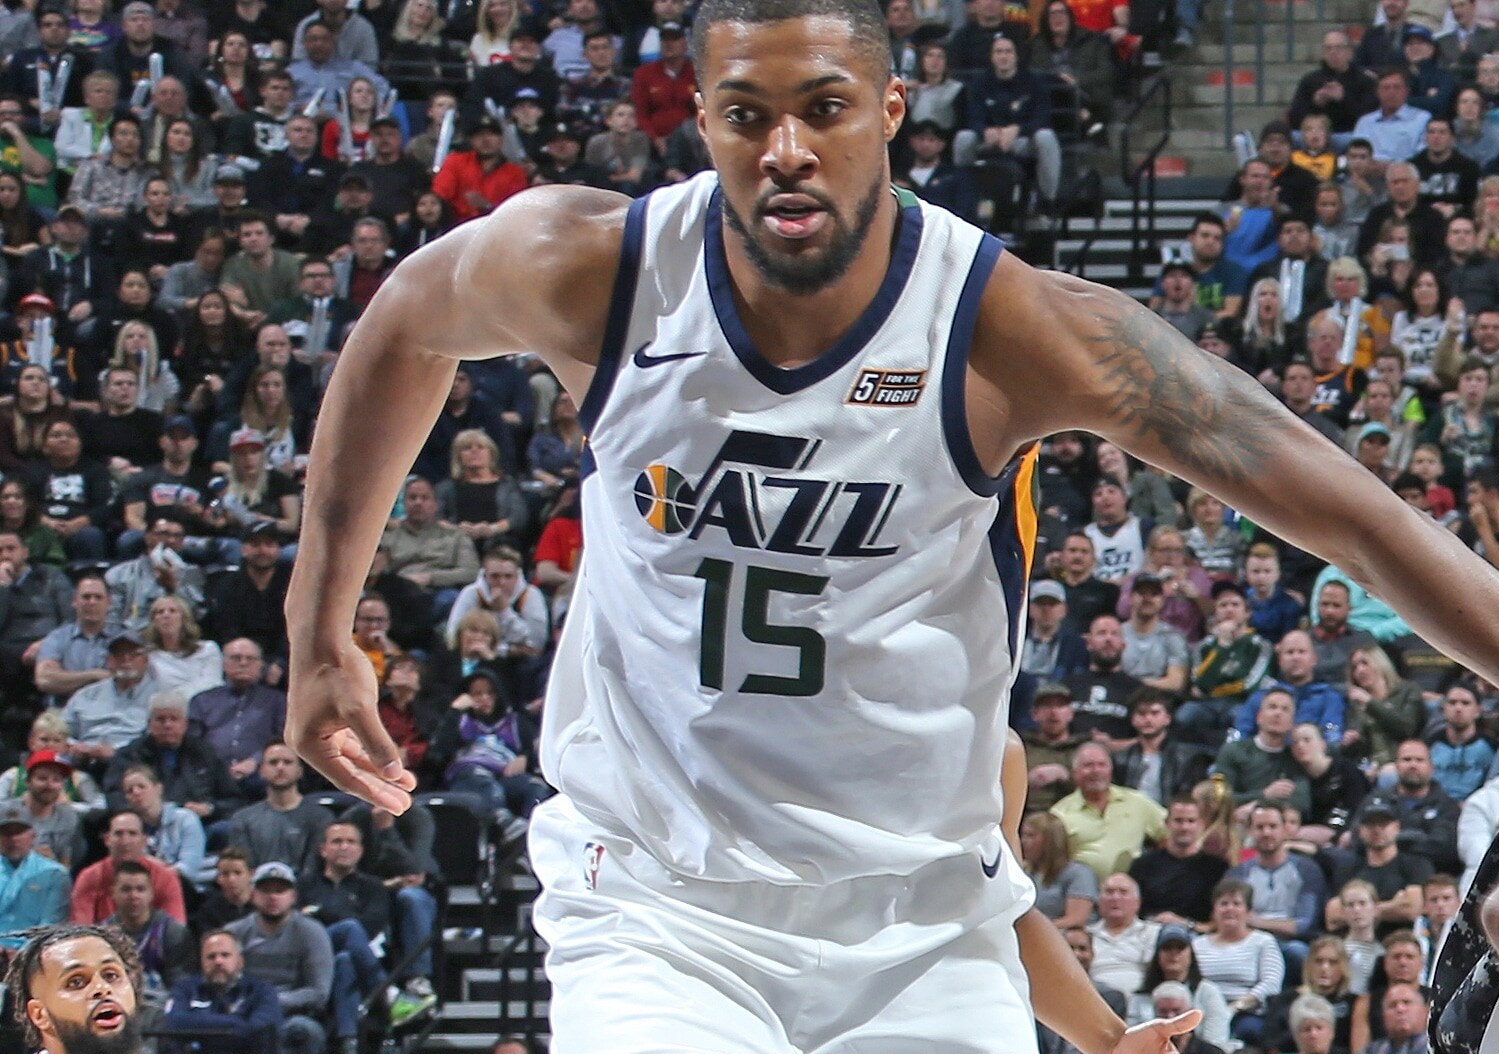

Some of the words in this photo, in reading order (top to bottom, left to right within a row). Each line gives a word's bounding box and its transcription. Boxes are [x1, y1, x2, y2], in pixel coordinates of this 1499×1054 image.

[854, 373, 880, 402] 5
[876, 388, 921, 403] FIGHT
[694, 557, 831, 697] 15
